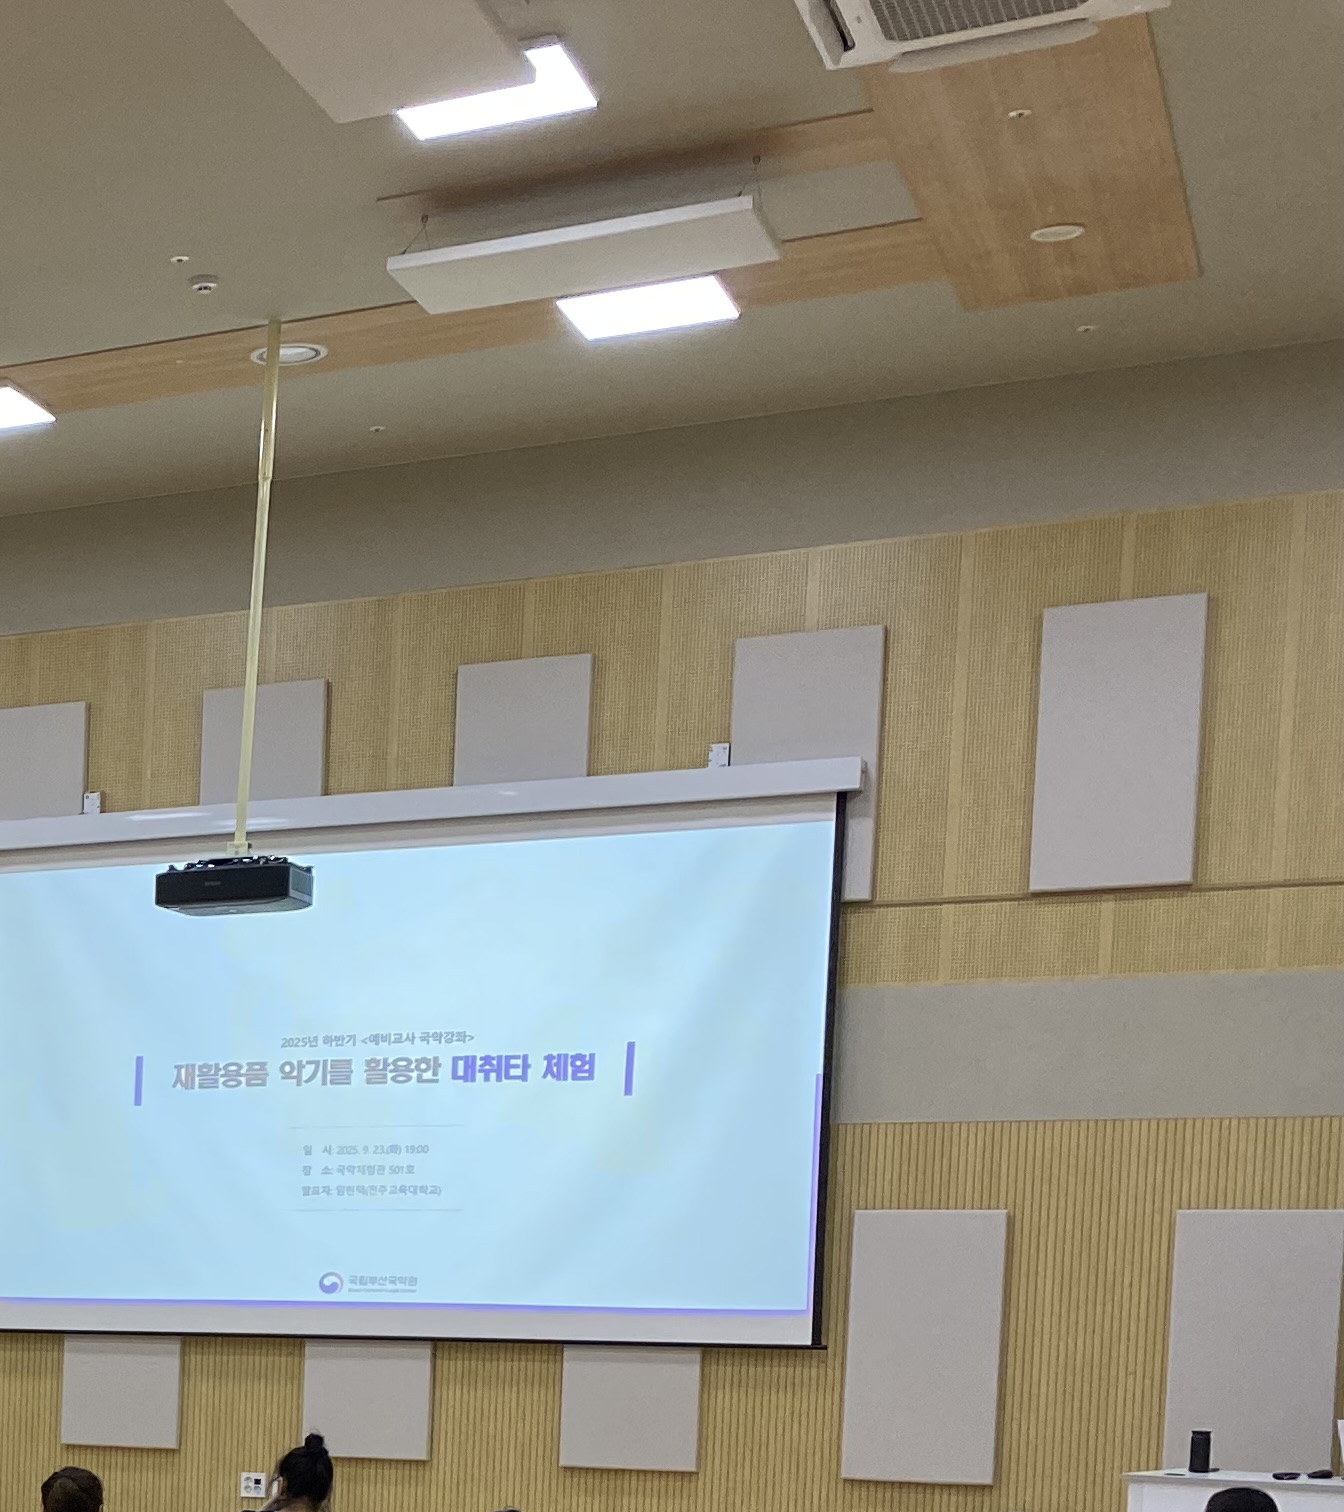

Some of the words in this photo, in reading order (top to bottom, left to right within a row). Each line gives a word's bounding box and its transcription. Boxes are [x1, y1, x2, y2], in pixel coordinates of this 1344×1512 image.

[280, 1035, 319, 1049] 2025년
[322, 1033, 357, 1048] 하반기
[360, 1031, 416, 1047] <예비교사
[418, 1030, 475, 1045] 국악강좌>
[172, 1060, 269, 1091] 재활용품
[278, 1058, 354, 1088] 악기를
[363, 1055, 442, 1086] 활용한
[451, 1053, 532, 1083] 대취타
[541, 1052, 596, 1082] 체험
[348, 1275, 418, 1287] 국립부산국악원
